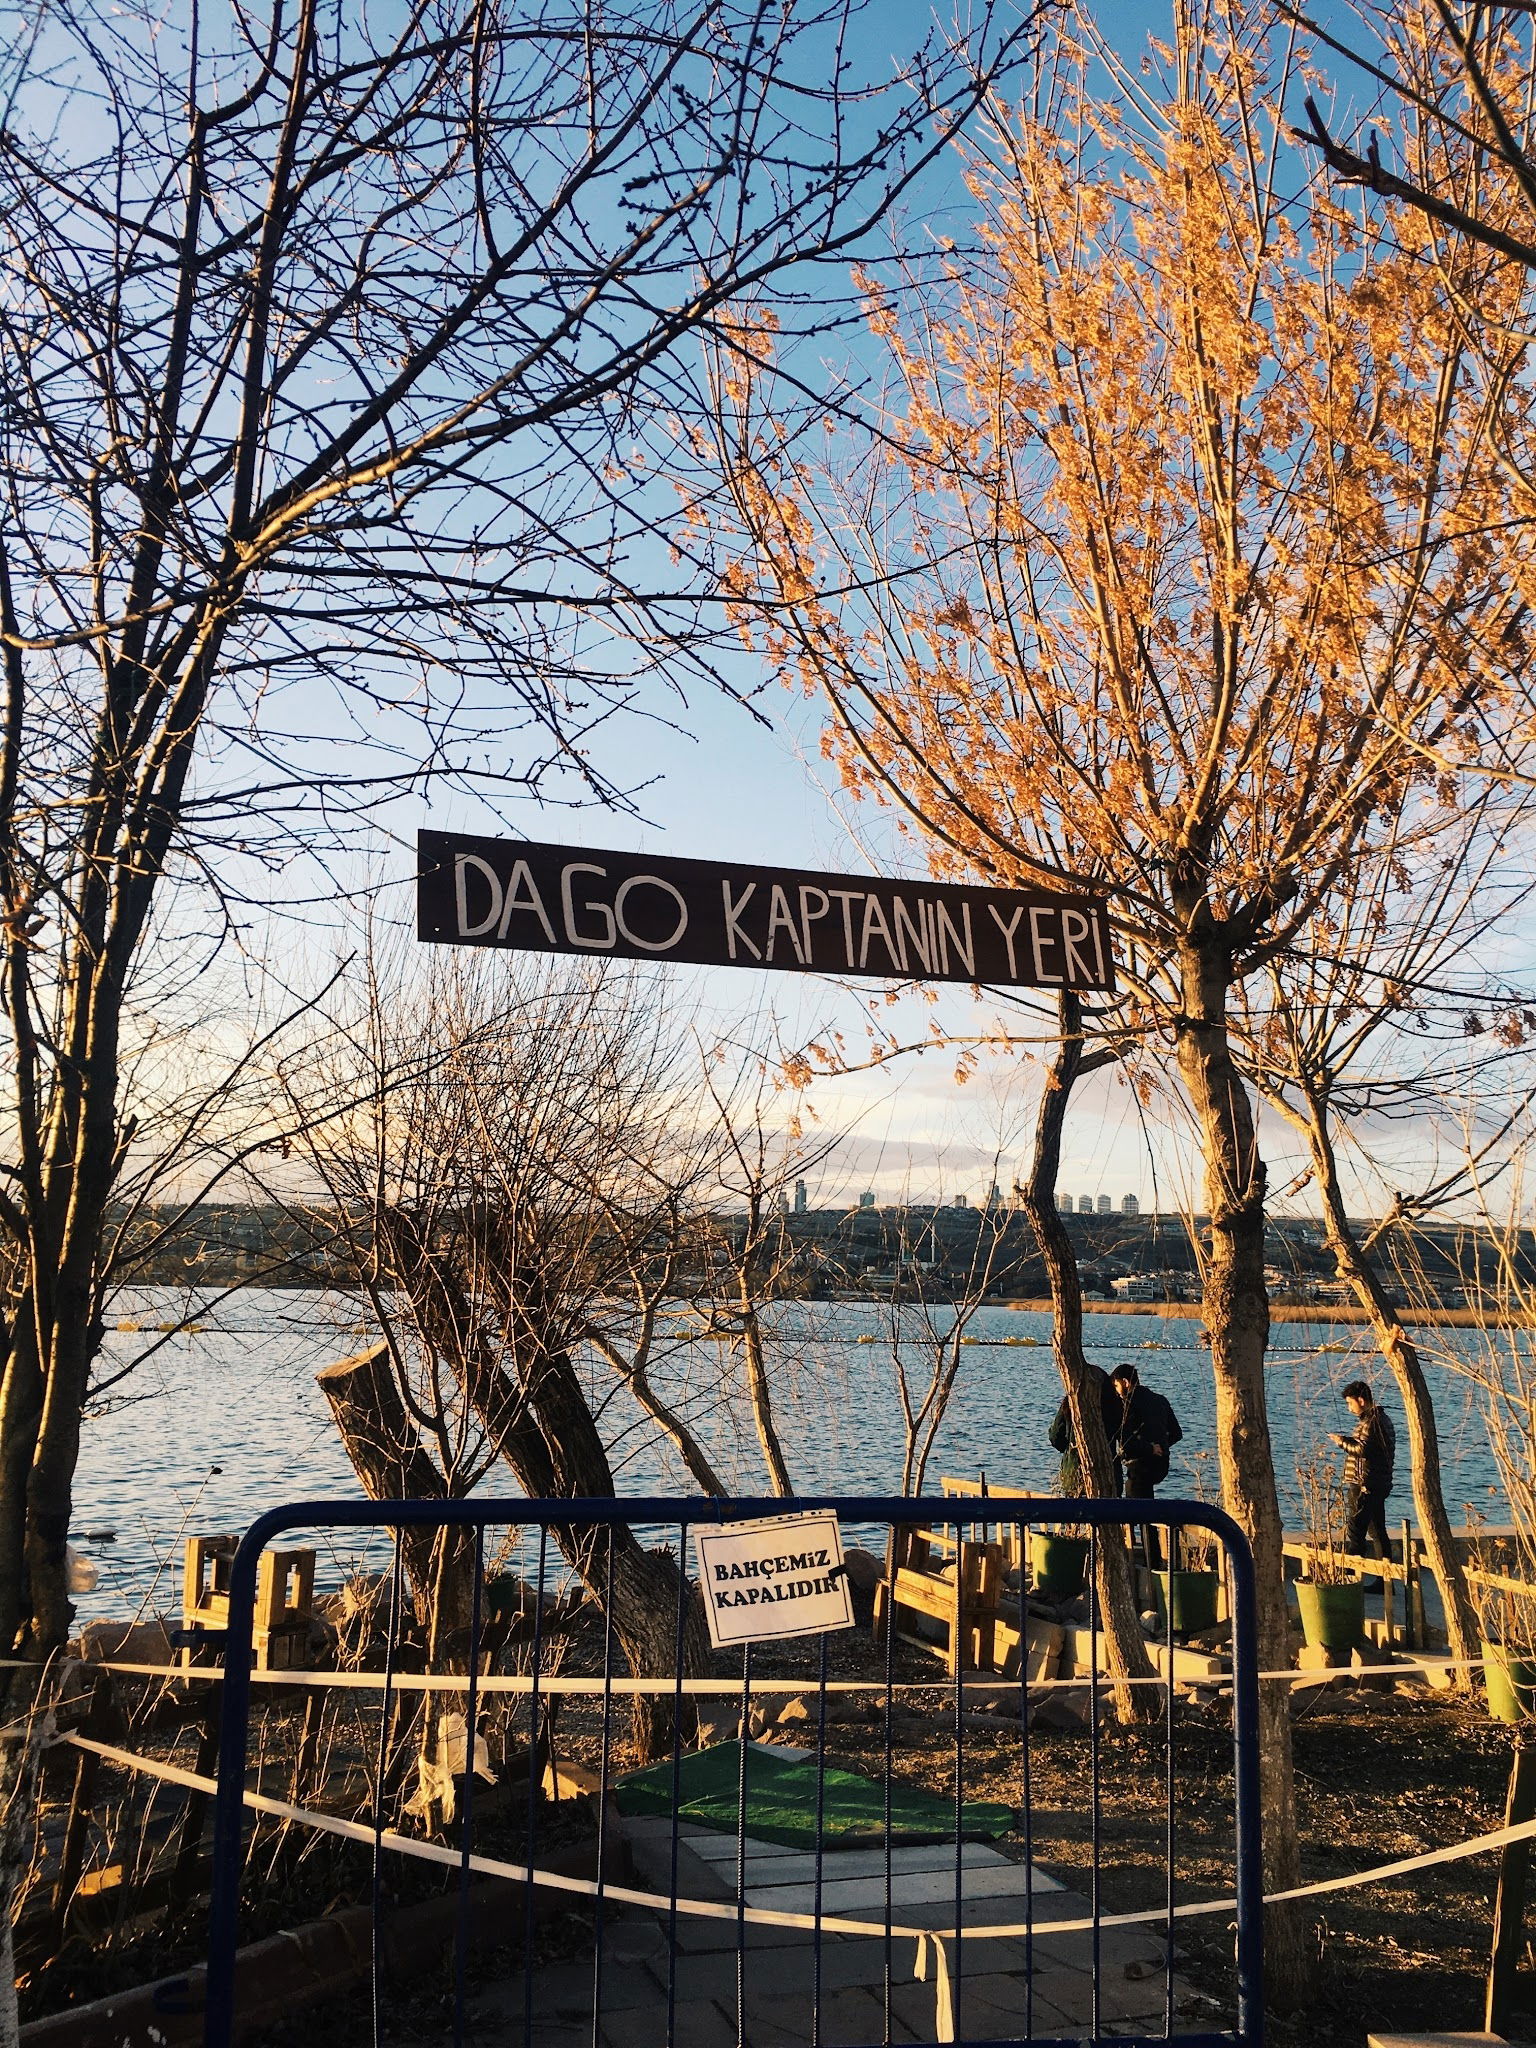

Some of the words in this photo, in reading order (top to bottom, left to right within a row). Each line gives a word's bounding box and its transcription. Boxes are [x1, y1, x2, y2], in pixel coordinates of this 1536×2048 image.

[454, 853, 688, 951] DAGO
[722, 879, 976, 976] KAPTANIN
[714, 1576, 840, 1609] KAPALIDIR
